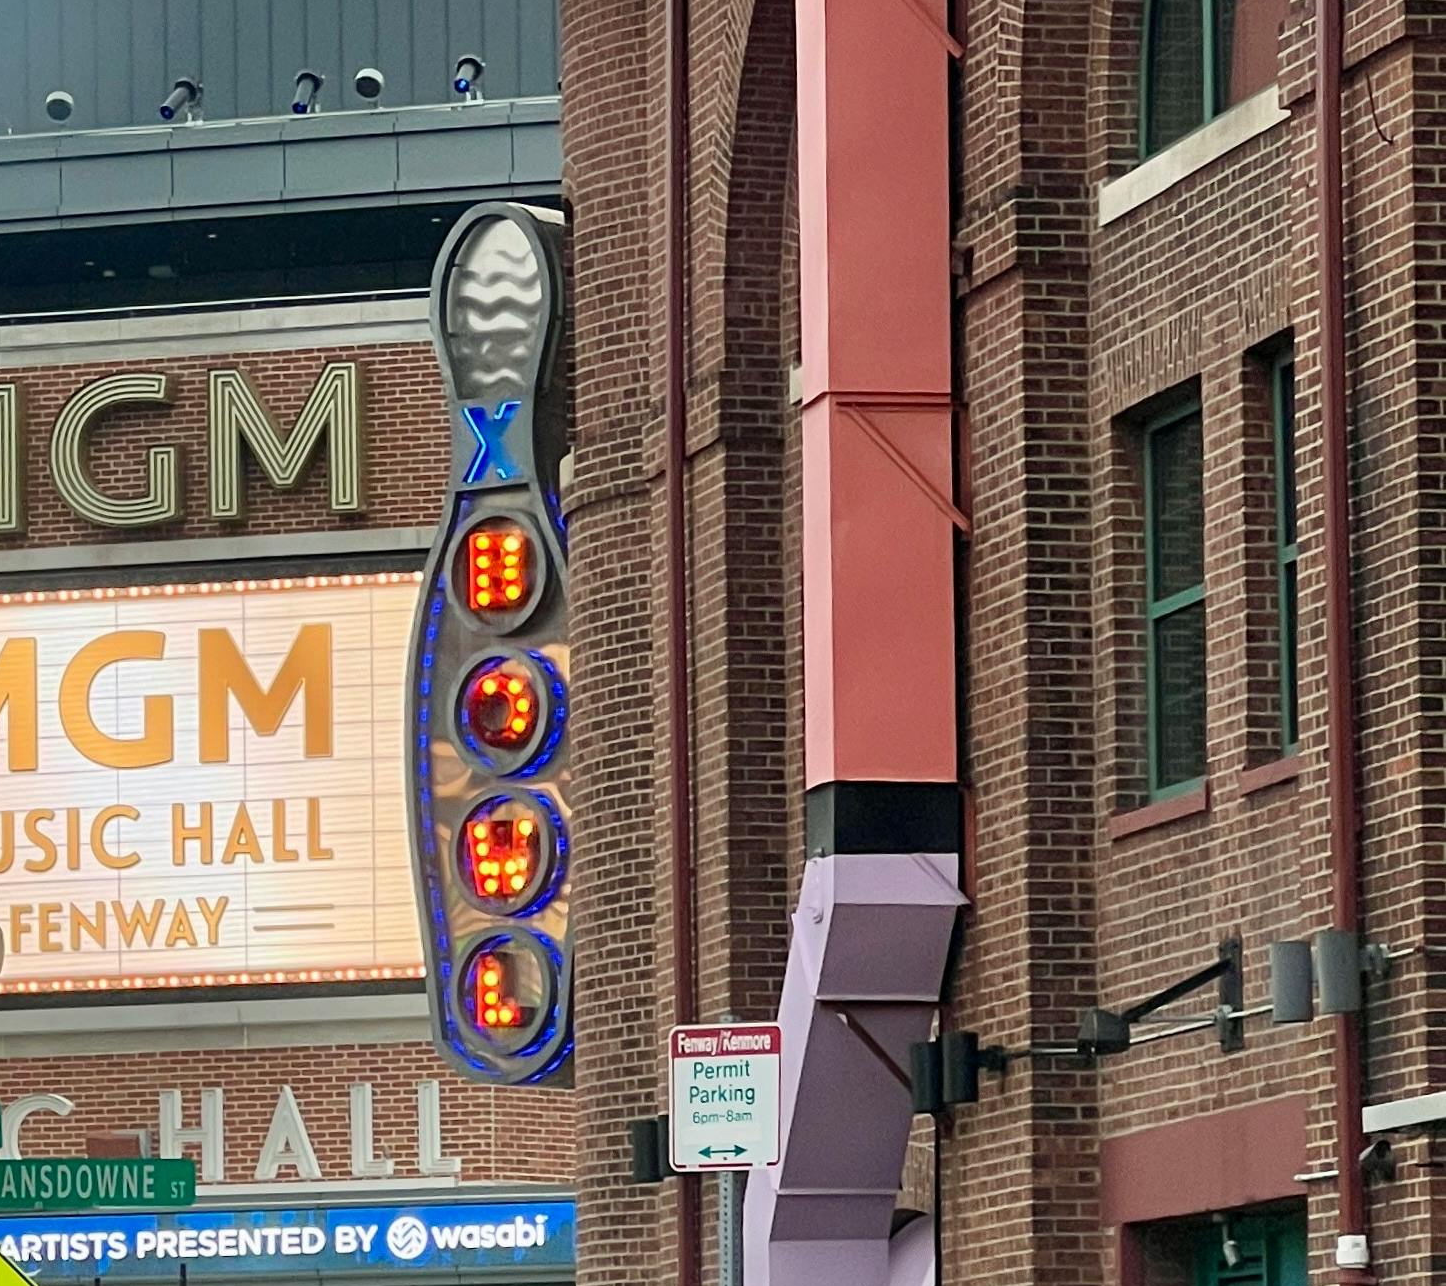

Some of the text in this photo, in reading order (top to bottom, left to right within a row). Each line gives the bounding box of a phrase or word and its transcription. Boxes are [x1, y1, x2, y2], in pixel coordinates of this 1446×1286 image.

[171, 797, 334, 866] HALL
[9, 896, 229, 954] FENWAY
[693, 1059, 751, 1080] Permit
[689, 1084, 756, 1106] Parking
[159, 1079, 461, 1182] HALL
[170, 1181, 186, 1199] ST
[0, 1231, 128, 1263] ARTISTS
[136, 1226, 326, 1260] PRESENTED
[335, 1223, 378, 1253] BY
[431, 1214, 550, 1249] wasabi
